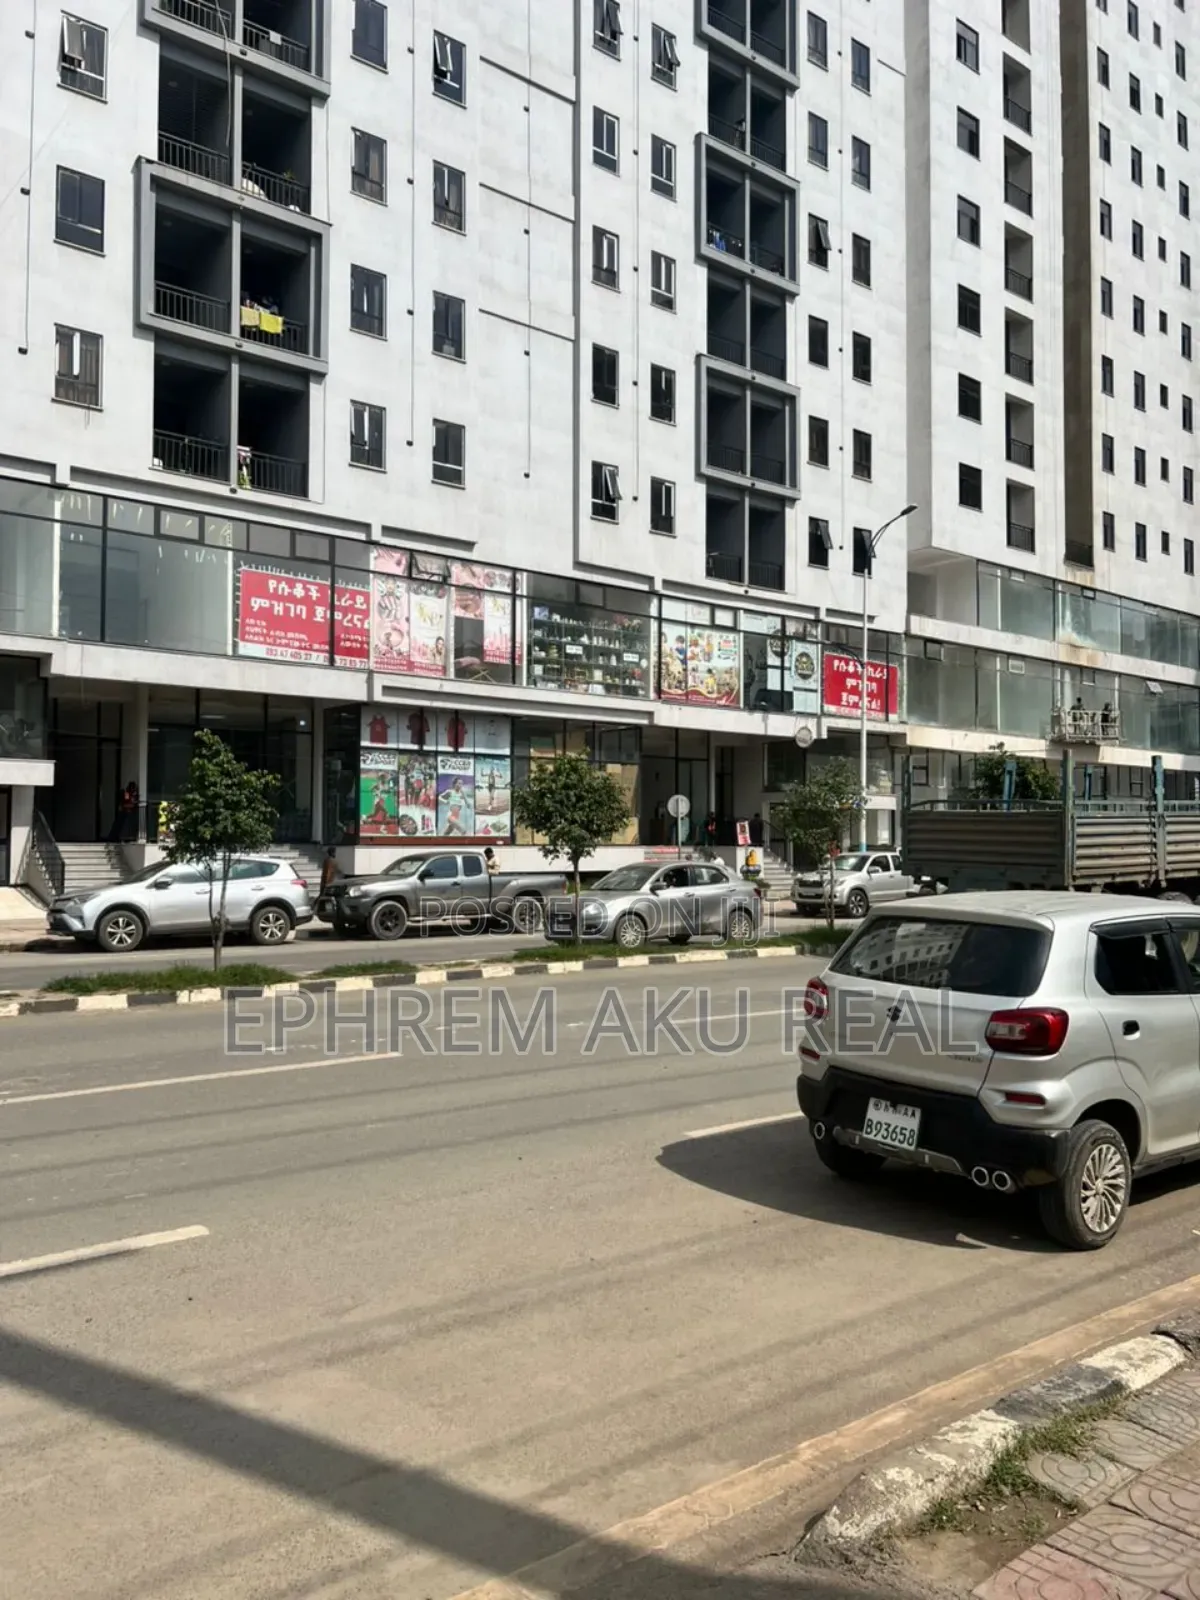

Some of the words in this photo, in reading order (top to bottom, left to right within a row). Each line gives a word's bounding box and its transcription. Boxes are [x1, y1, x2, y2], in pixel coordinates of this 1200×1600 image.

[250, 597, 307, 620] ምዝገባ
[841, 692, 880, 710] ጀምናል!
[865, 1118, 916, 1146] B93658
